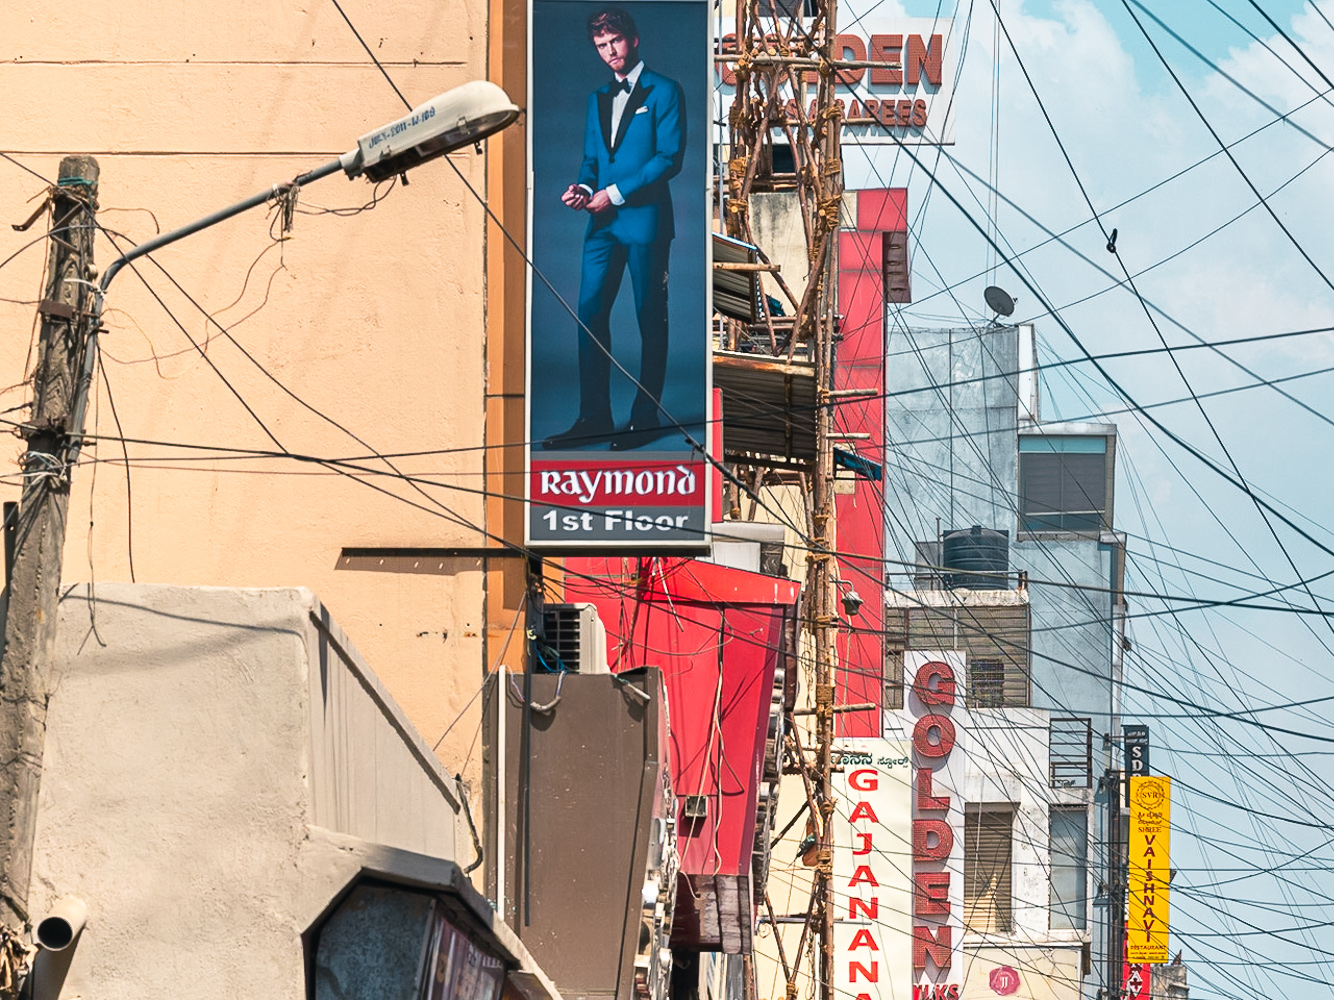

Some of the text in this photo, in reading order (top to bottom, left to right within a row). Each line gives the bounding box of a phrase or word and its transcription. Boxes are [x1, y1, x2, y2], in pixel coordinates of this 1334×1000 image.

[543, 510, 689, 531] 1st Floor
[912, 661, 956, 969] GOLDEN
[1143, 834, 1156, 943] VAISHNAVI
